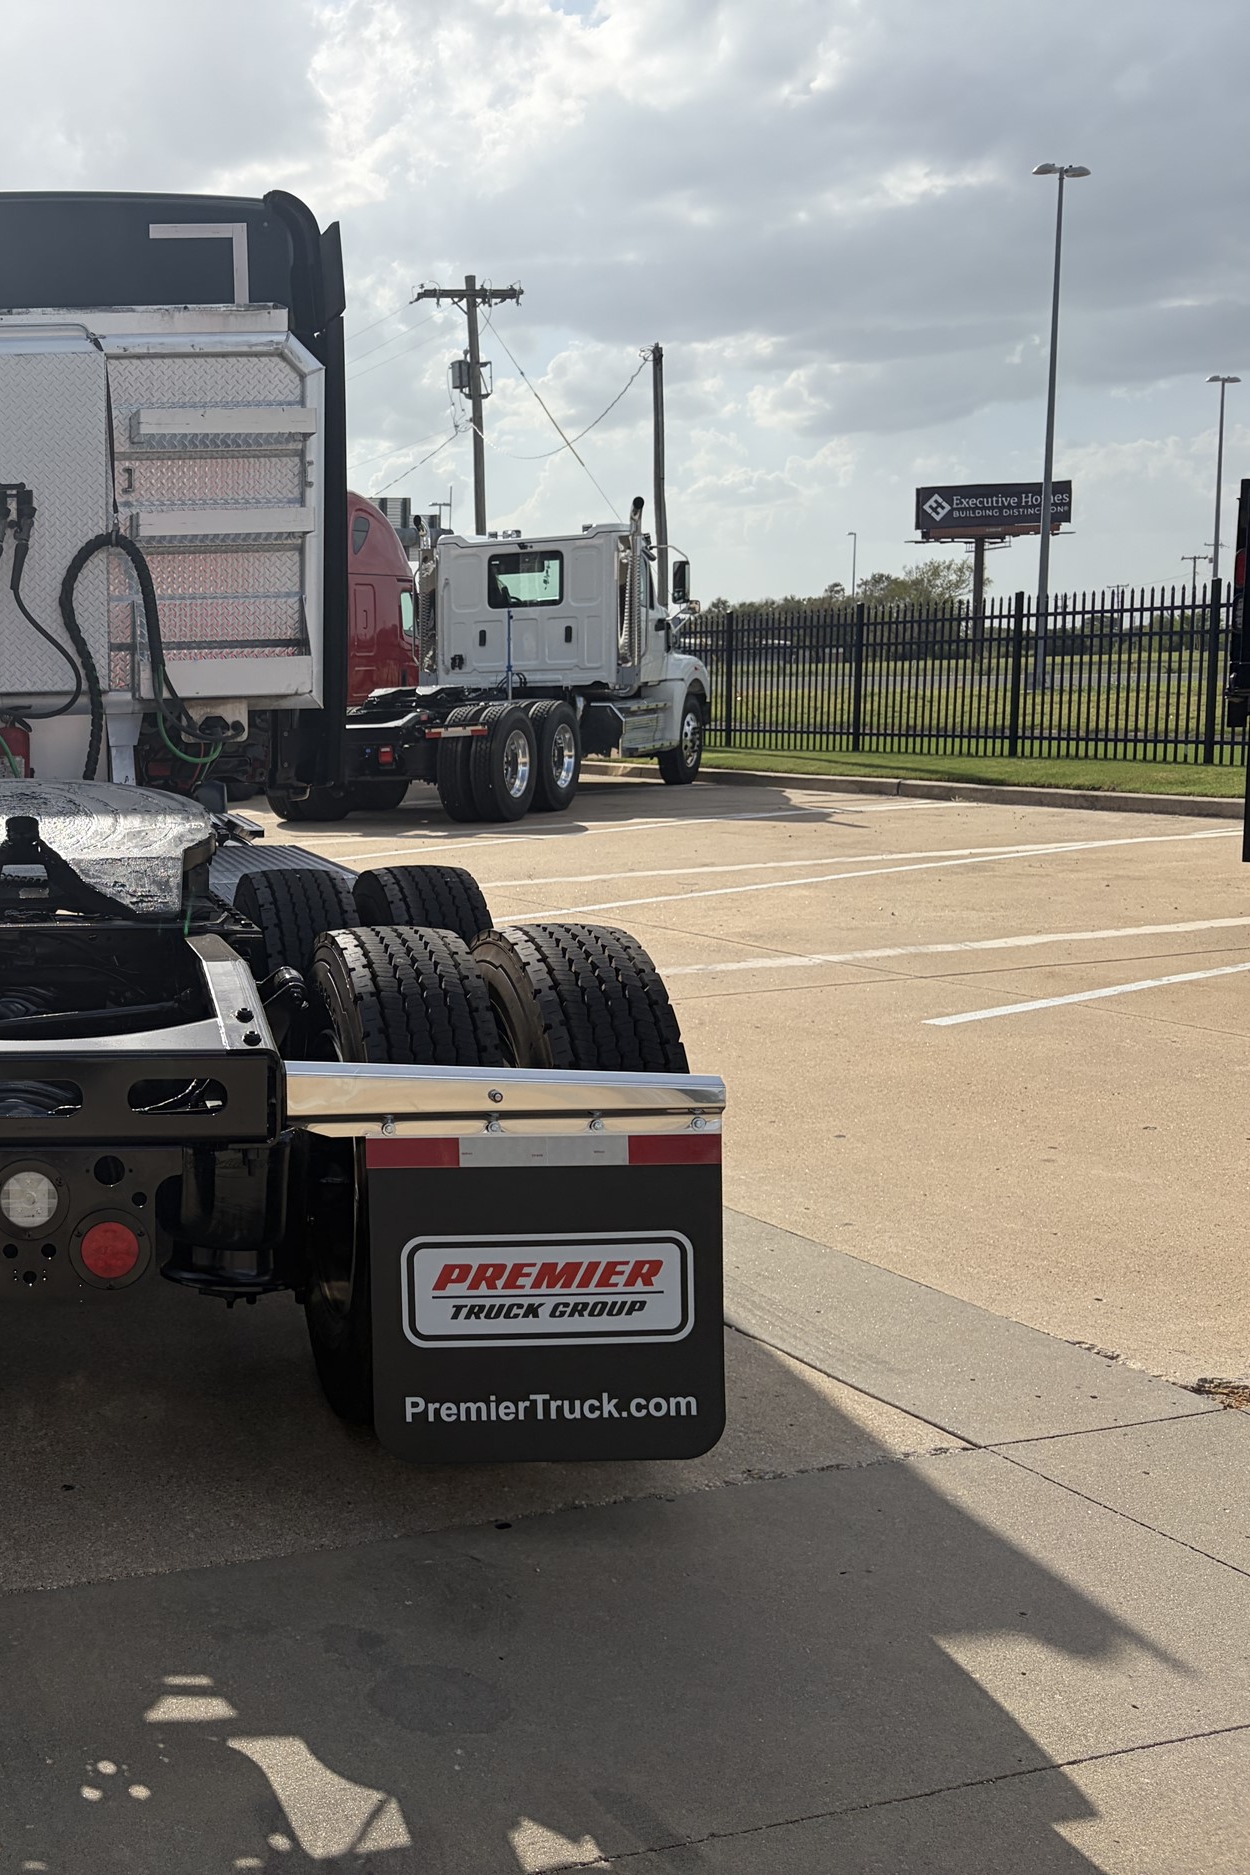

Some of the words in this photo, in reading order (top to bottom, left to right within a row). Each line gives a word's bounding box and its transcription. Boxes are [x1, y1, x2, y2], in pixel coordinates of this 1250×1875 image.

[952, 494, 1018, 508] Executive
[952, 509, 1000, 518] BUILDING
[432, 1259, 664, 1291] PREMIER
[450, 1301, 546, 1320] TRUCK
[549, 1300, 647, 1318] GROUP
[404, 1392, 698, 1422] PremierTruck.com
